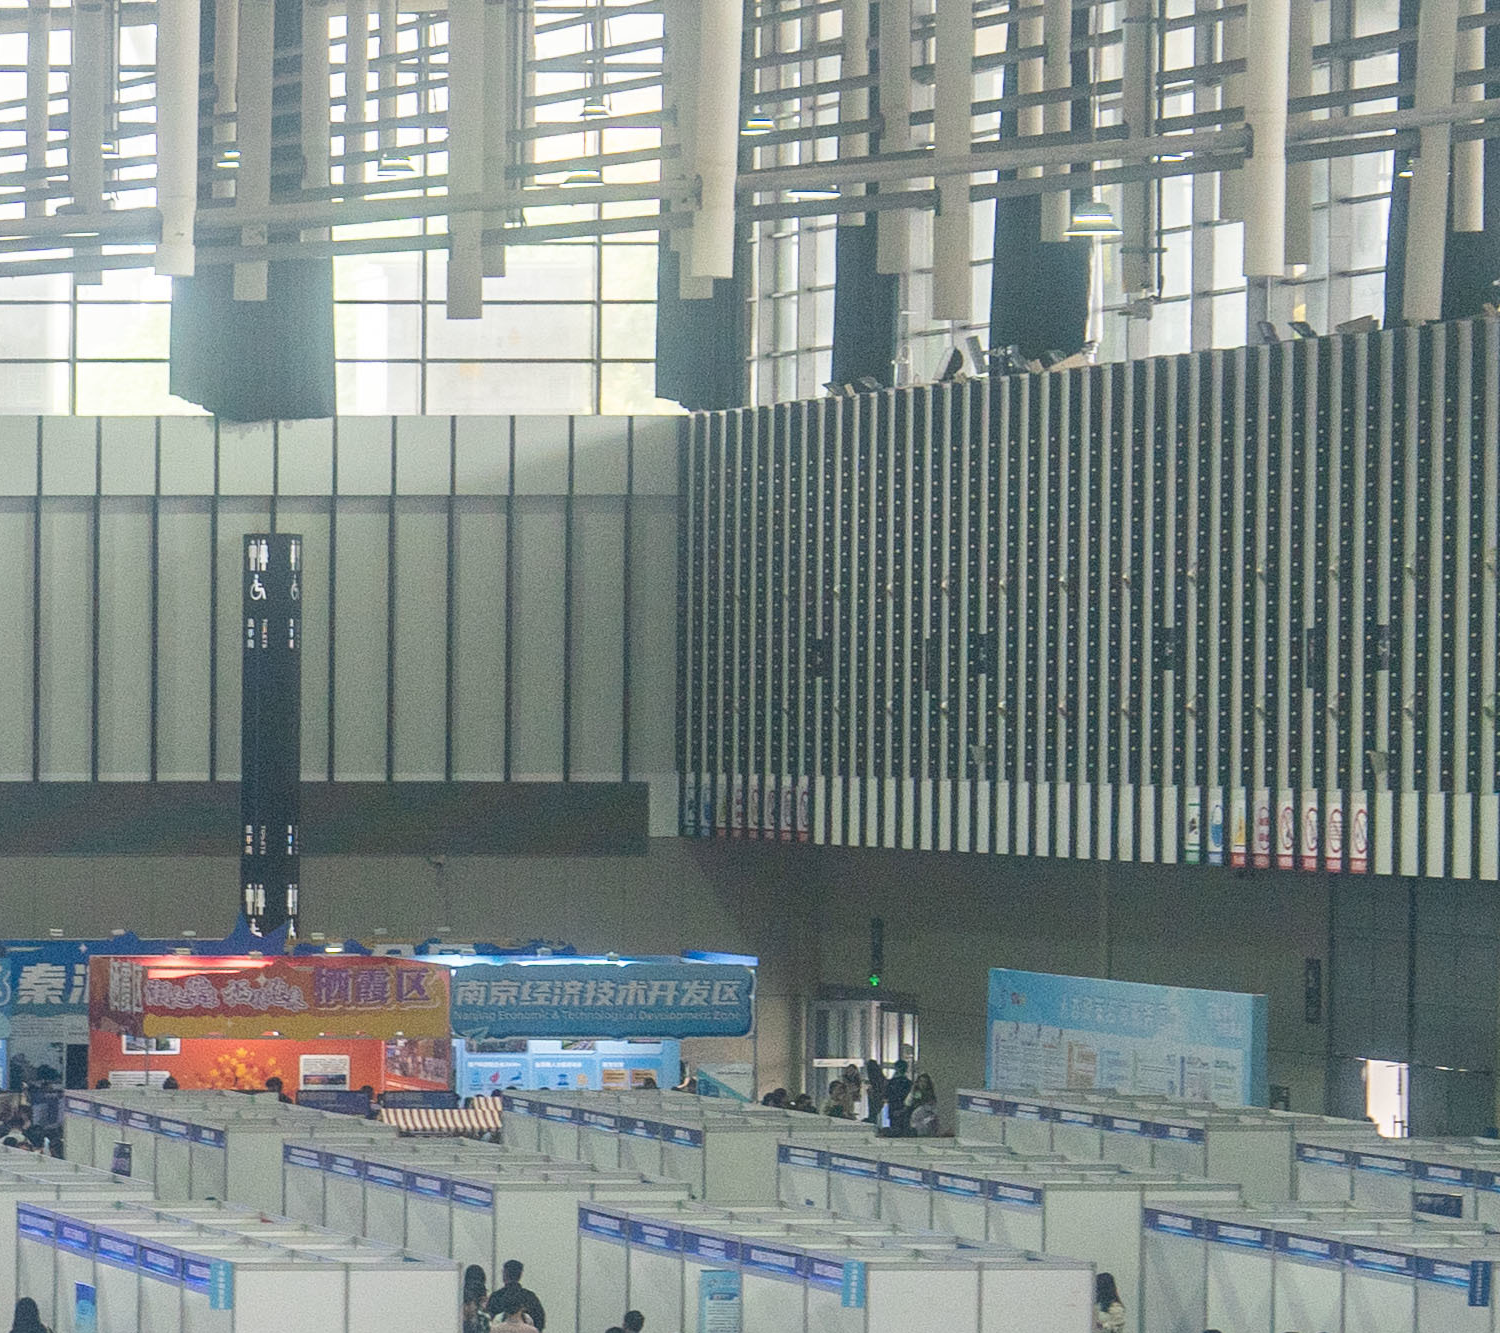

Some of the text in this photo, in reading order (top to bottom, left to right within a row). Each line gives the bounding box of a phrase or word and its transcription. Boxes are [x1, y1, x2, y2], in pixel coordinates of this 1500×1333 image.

[314, 967, 431, 1005] 栖霞区
[456, 980, 742, 1007] 南京经济技术开发区
